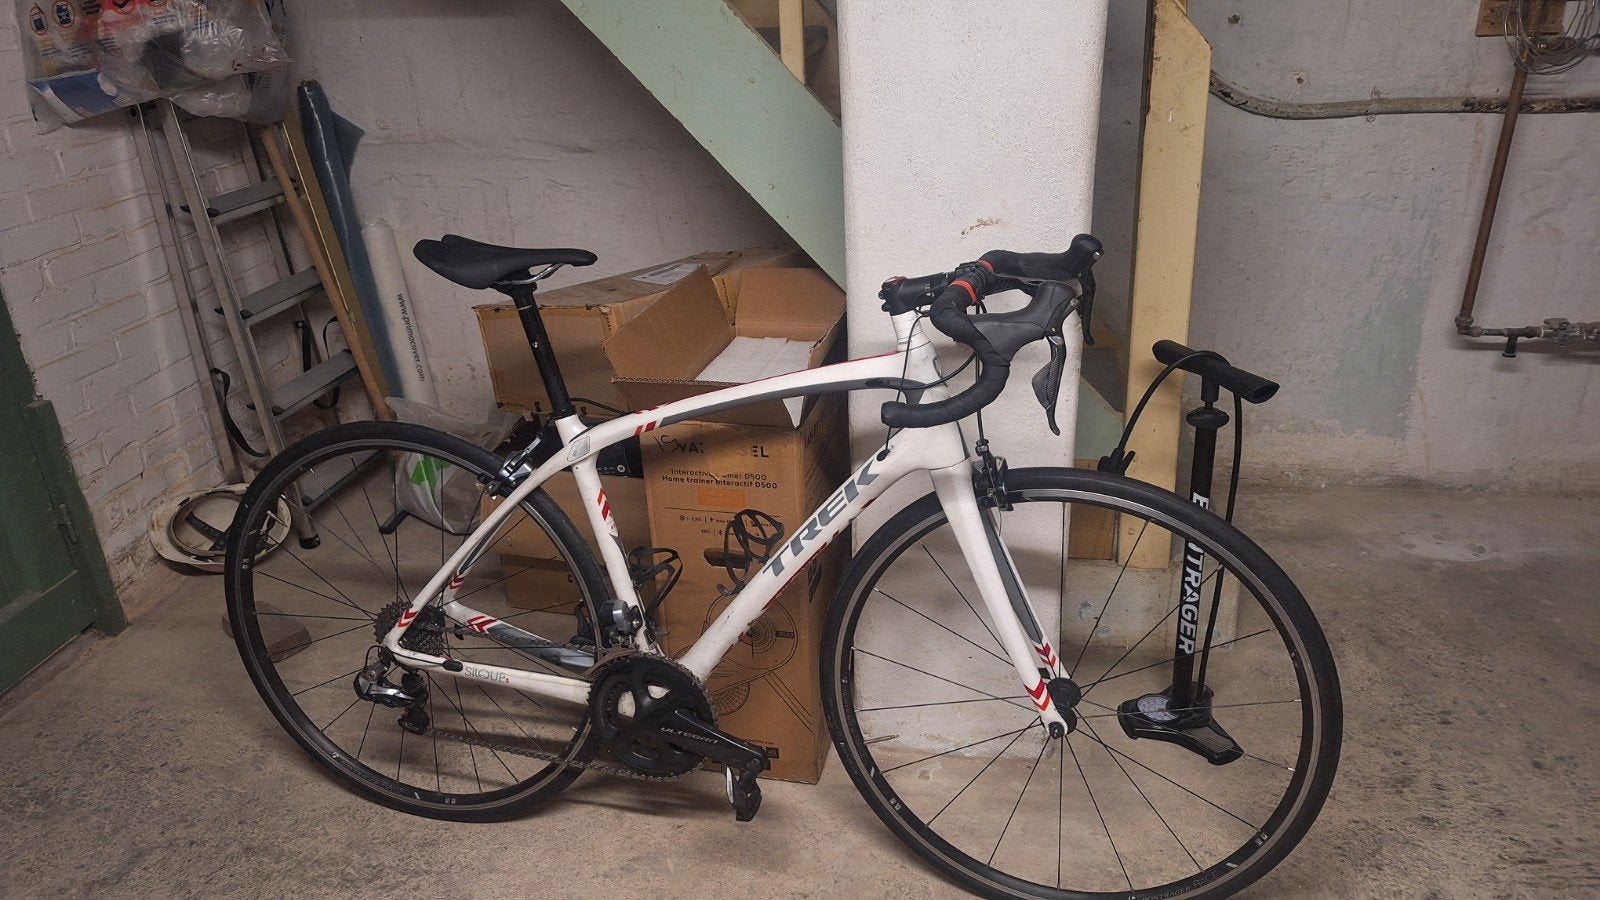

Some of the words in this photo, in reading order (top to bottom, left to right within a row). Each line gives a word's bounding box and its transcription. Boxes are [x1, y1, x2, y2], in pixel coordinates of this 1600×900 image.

[397, 293, 426, 382] www.primacover.com
[662, 475, 685, 483] Home
[686, 475, 714, 485] trainer
[755, 481, 778, 489] D500
[744, 473, 767, 481] D500
[762, 458, 880, 577] TREK
